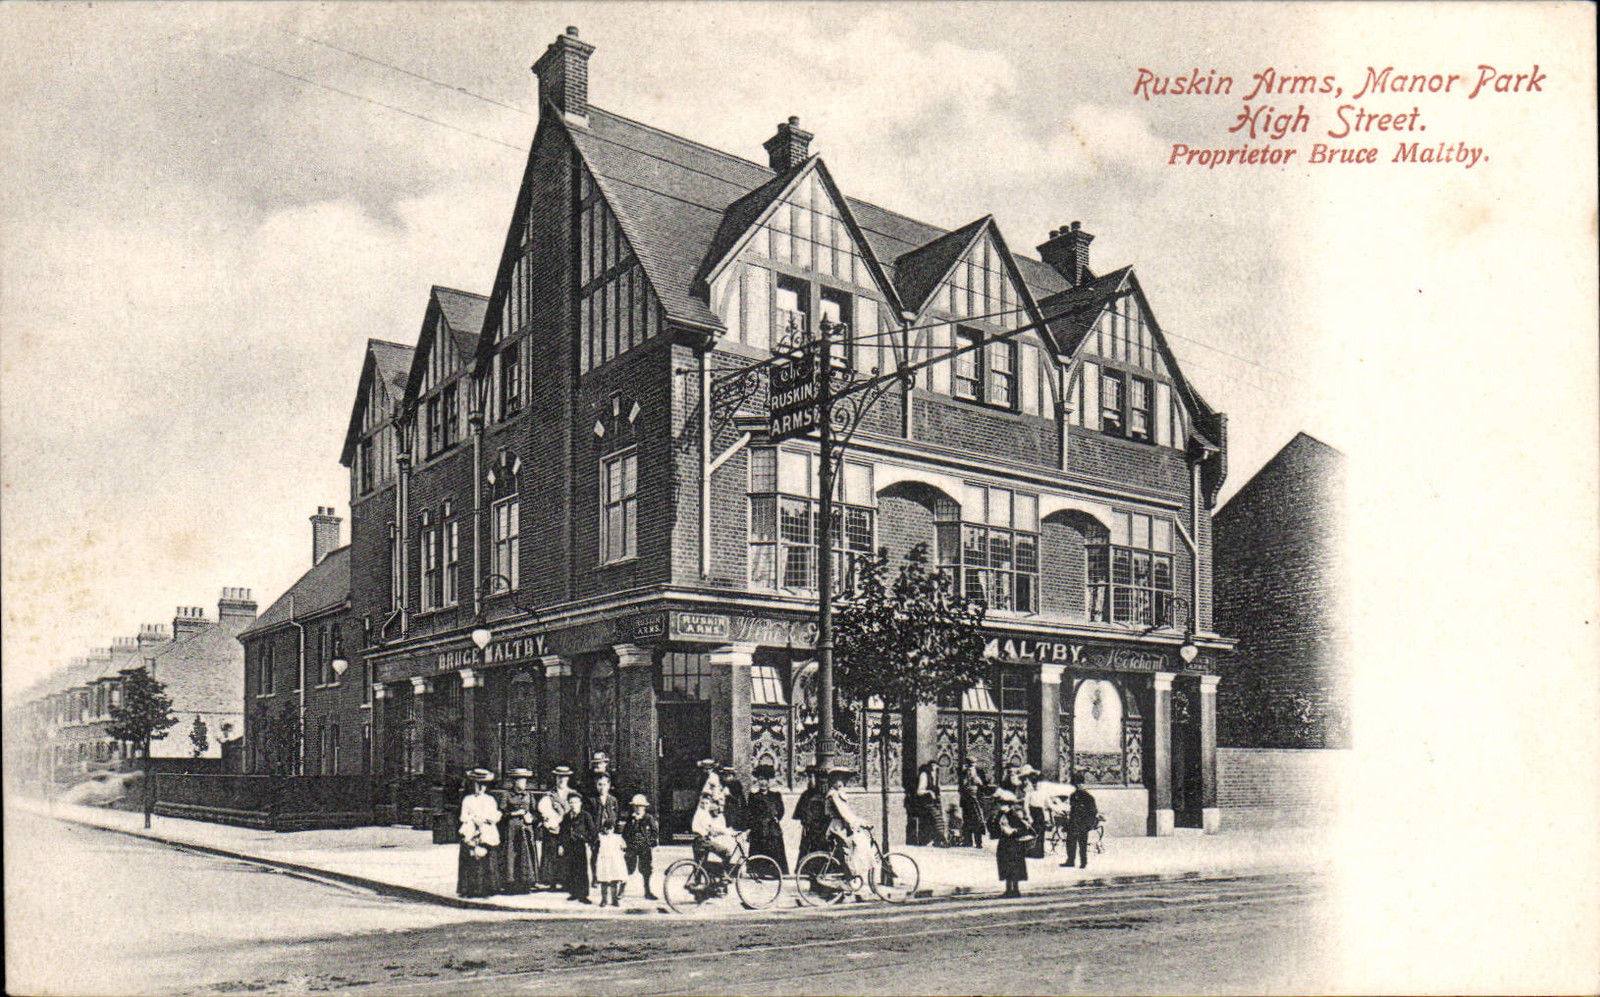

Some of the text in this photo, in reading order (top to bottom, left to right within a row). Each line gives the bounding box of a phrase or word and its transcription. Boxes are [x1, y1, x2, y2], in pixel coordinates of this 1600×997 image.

[771, 382, 813, 411] RUSKIN
[772, 408, 812, 437] ARMS
[682, 615, 726, 625] RUSKIN
[687, 624, 720, 634] ARMS
[439, 647, 480, 671] BRUCE
